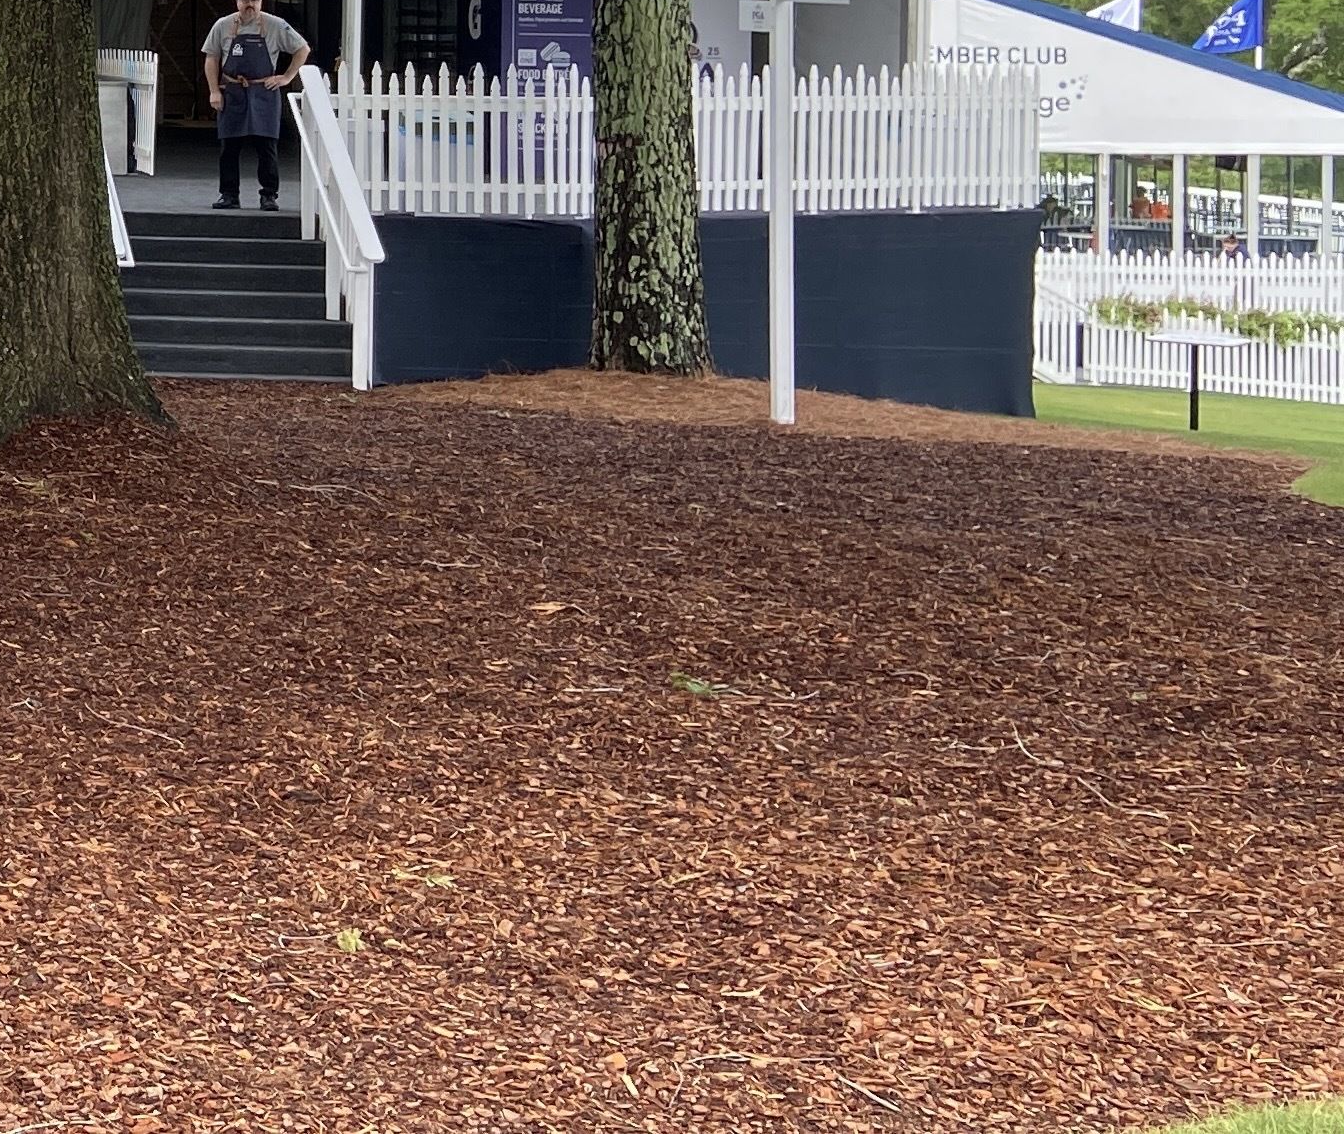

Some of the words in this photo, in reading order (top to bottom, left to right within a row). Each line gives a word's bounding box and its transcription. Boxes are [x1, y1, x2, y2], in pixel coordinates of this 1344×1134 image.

[518, 2, 563, 14] BEVERAGE
[707, 46, 720, 56] 25
[1008, 47, 1067, 65] CLUB
[517, 69, 541, 80] FOOD
